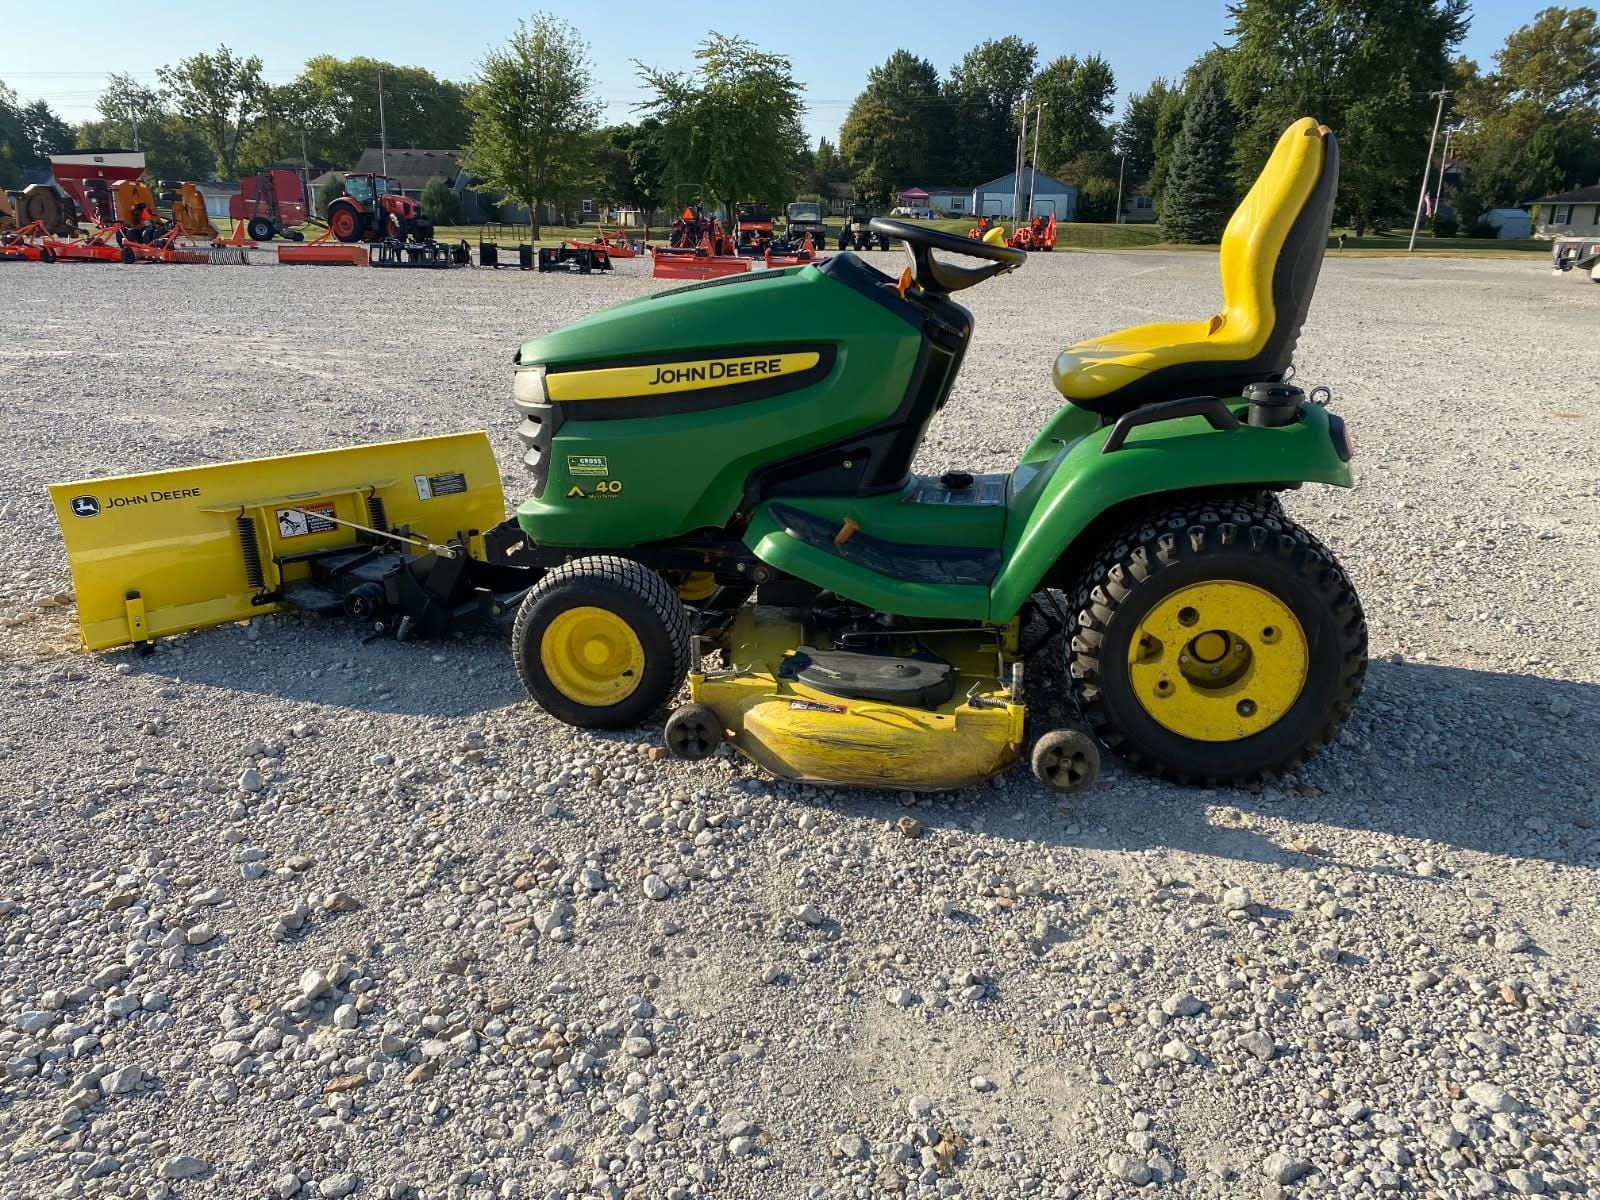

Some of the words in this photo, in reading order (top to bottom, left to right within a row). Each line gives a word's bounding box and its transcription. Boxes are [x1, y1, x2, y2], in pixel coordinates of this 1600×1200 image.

[649, 367, 706, 385] JOHN
[709, 359, 782, 379] DEERE
[106, 495, 148, 509] JOHN
[150, 488, 201, 503] DEERE
